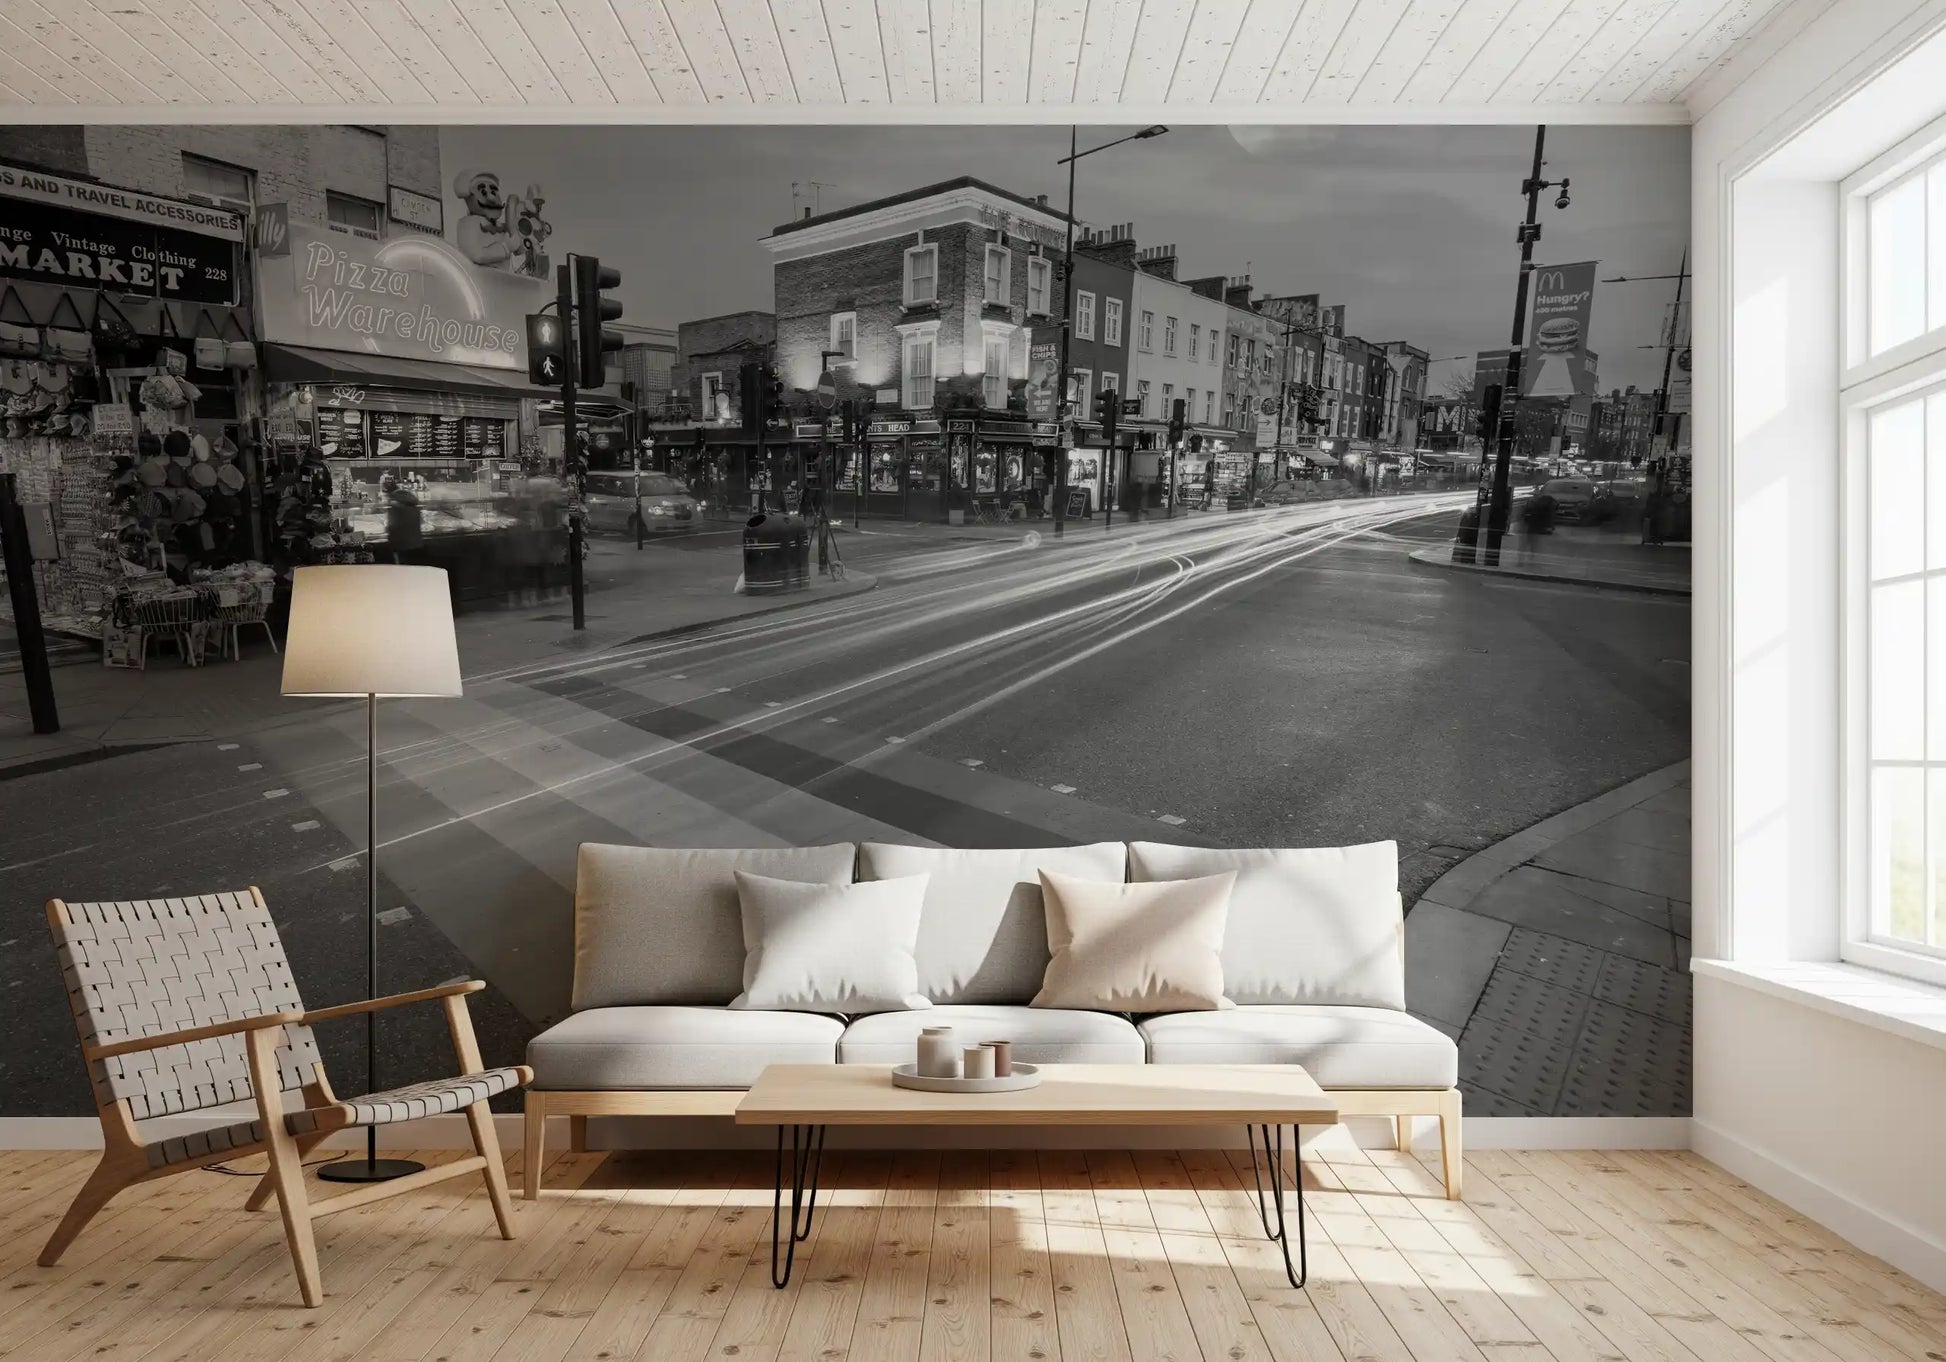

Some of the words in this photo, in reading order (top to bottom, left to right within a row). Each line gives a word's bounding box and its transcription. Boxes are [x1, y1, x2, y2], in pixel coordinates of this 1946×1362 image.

[21, 175, 59, 194] AND
[66, 184, 130, 209] TRAVEL
[135, 201, 238, 230] ACCESSORIES
[51, 231, 116, 255] Vintage
[131, 245, 197, 269] Clothing
[0, 240, 184, 290] MARKET
[205, 267, 228, 281] 228
[307, 240, 409, 298] Pizza
[1536, 291, 1590, 307] Hungry?
[1550, 305, 1578, 314] metres
[303, 284, 519, 353] Warehouse
[1031, 345, 1049, 353] FISH
[1031, 351, 1056, 360] CHIPS
[887, 423, 910, 432] HEAD
